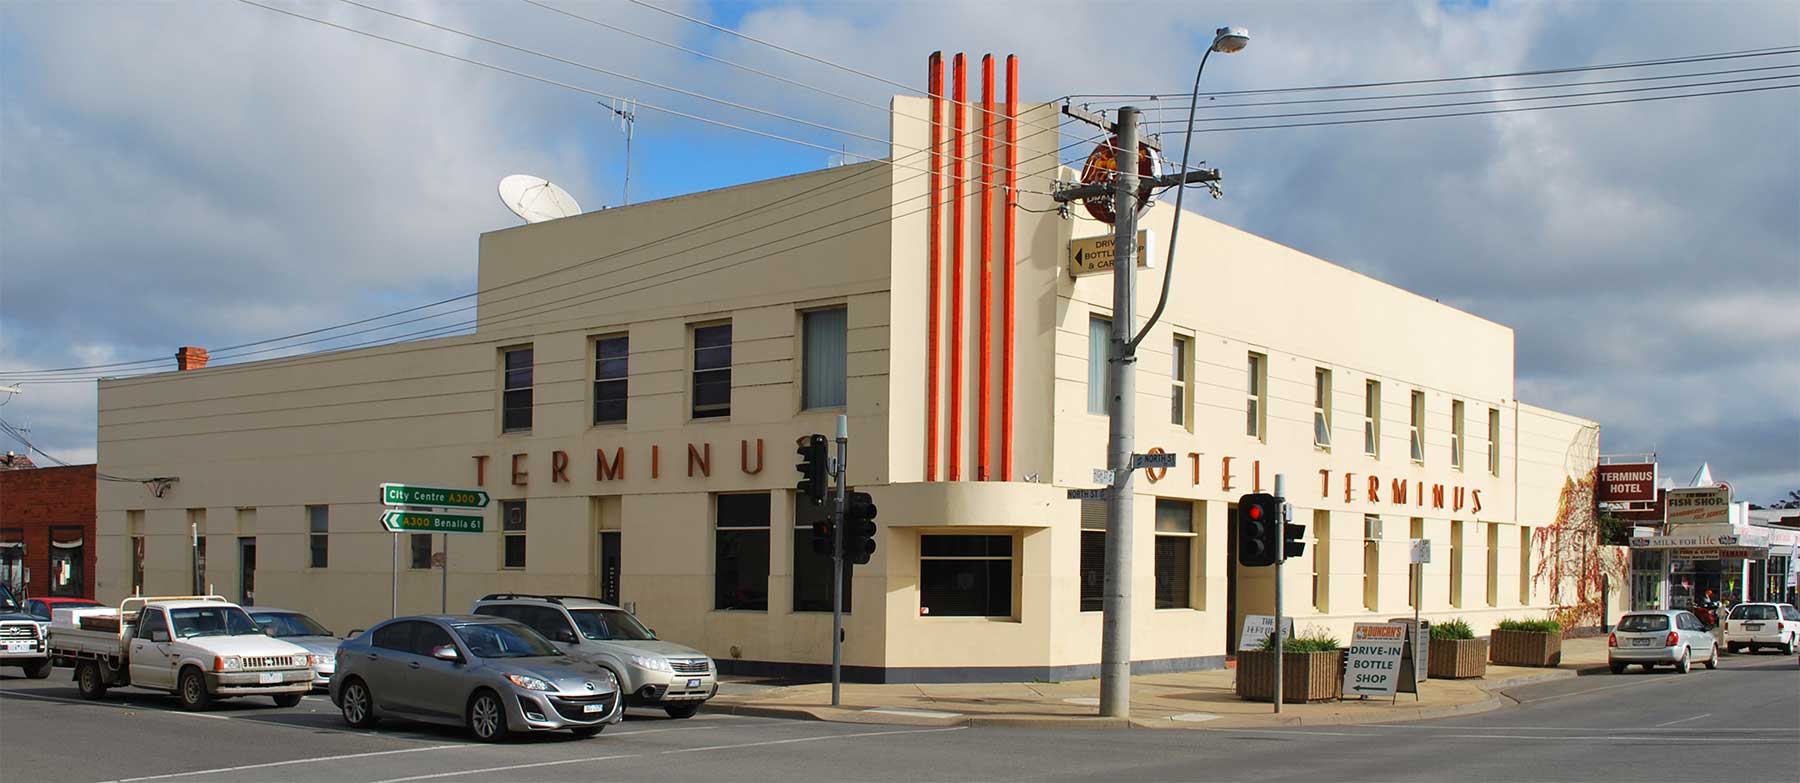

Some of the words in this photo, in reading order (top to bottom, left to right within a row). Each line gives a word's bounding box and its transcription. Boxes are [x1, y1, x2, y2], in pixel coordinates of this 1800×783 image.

[1085, 250, 1115, 259] BOTTL
[472, 435, 809, 487] TERMINU
[1144, 454, 1166, 463] NORTH
[1167, 455, 1176, 463] ST
[1147, 447, 1265, 492] OTEL
[1320, 468, 1482, 514] TERMINUS
[1601, 471, 1653, 482] TERMINUS
[1610, 483, 1642, 493] HOTEL
[389, 490, 409, 501] City
[414, 491, 444, 502] Centre
[449, 494, 475, 503] A300
[1067, 489, 1089, 498] NORTH
[1090, 490, 1098, 498] ST
[1669, 498, 1692, 506] FISH
[1695, 498, 1723, 506] SHOP
[403, 517, 430, 526] A300
[434, 518, 468, 528] Benalla
[471, 520, 481, 528] 61
[1699, 536, 1715, 545] life
[1350, 646, 1401, 655] DRIVE-IN
[1354, 660, 1393, 669] BOTTLE
[1356, 674, 1387, 683] SHOP
